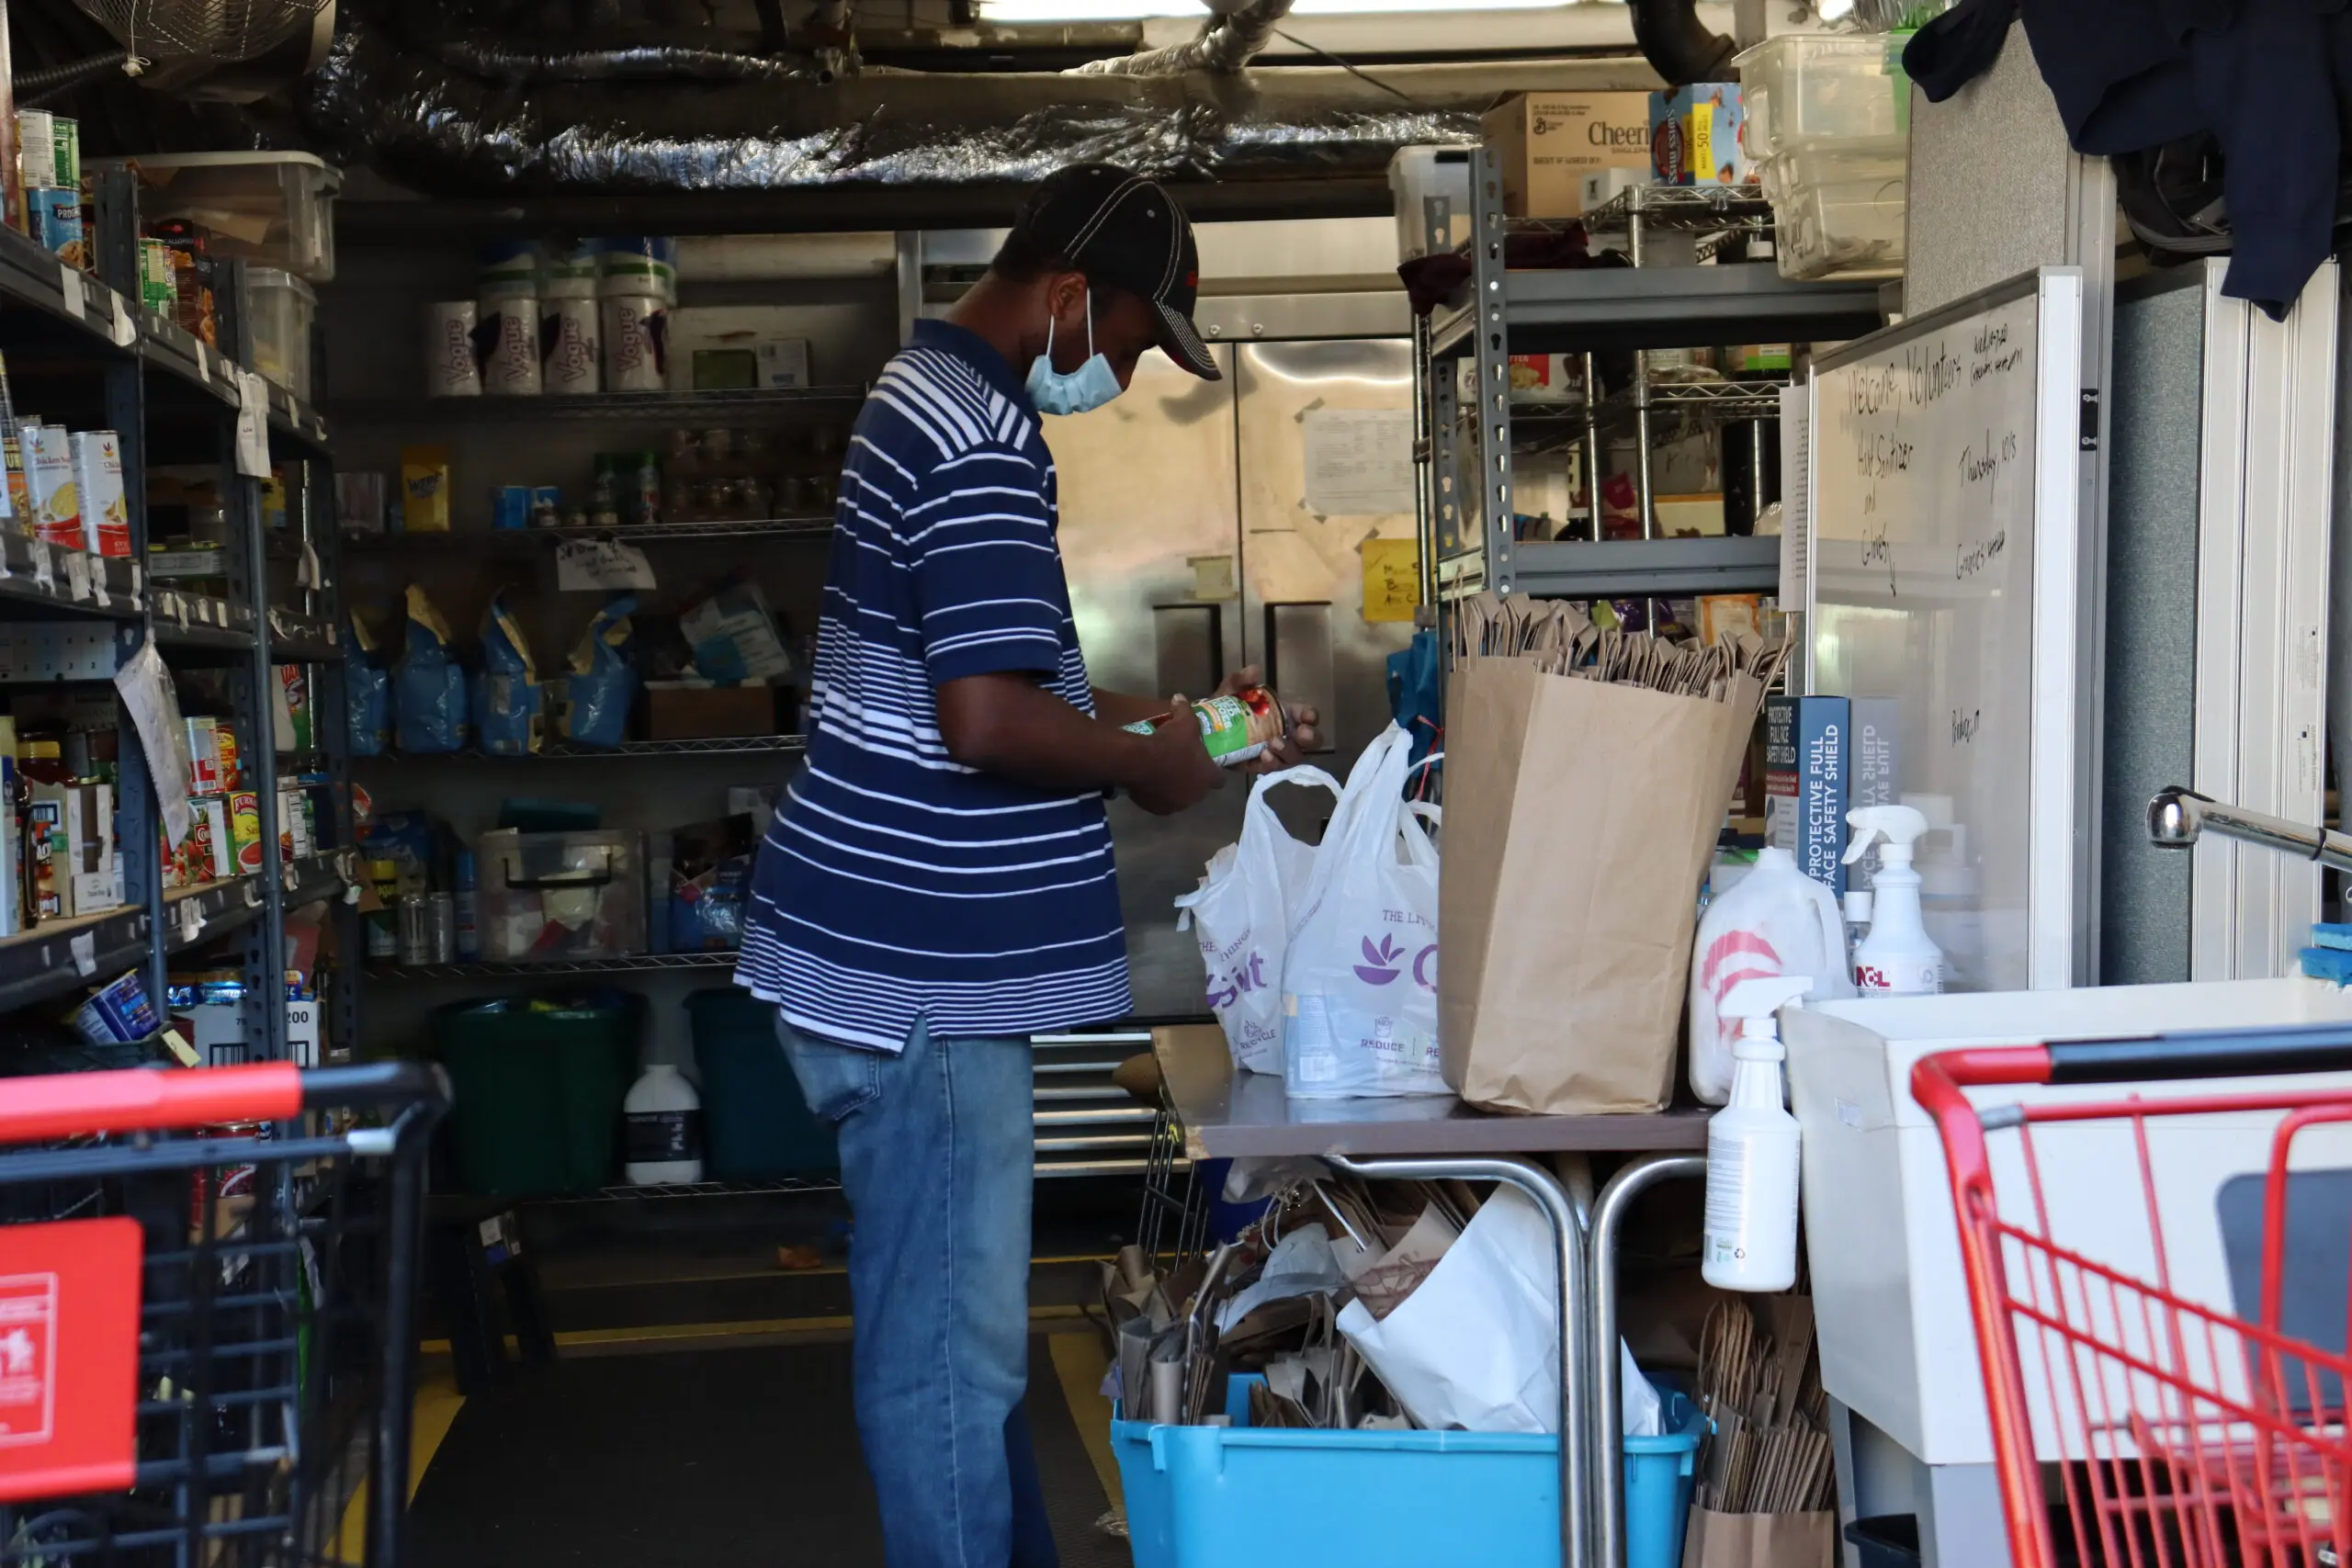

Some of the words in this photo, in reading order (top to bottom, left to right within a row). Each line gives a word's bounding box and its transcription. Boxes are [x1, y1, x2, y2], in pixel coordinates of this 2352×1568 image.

[1697, 132, 1709, 147] 50
[446, 319, 469, 386] Vogue
[505, 316, 524, 382] Vogue
[557, 318, 588, 383] Vogue
[615, 307, 643, 374] Vogue
[1810, 737, 1824, 774] FULL
[1825, 724, 1838, 781] SHIELD
[1808, 780, 1823, 876] PROTECTIVE
[1823, 786, 1838, 845] SAFETY
[1823, 850, 1837, 890] FACE
[1382, 909, 1404, 922] THE
[1856, 964, 1891, 989] NCL
[1240, 1029, 1276, 1051] RECYCLE
[1361, 1038, 1405, 1053] REDUCE
